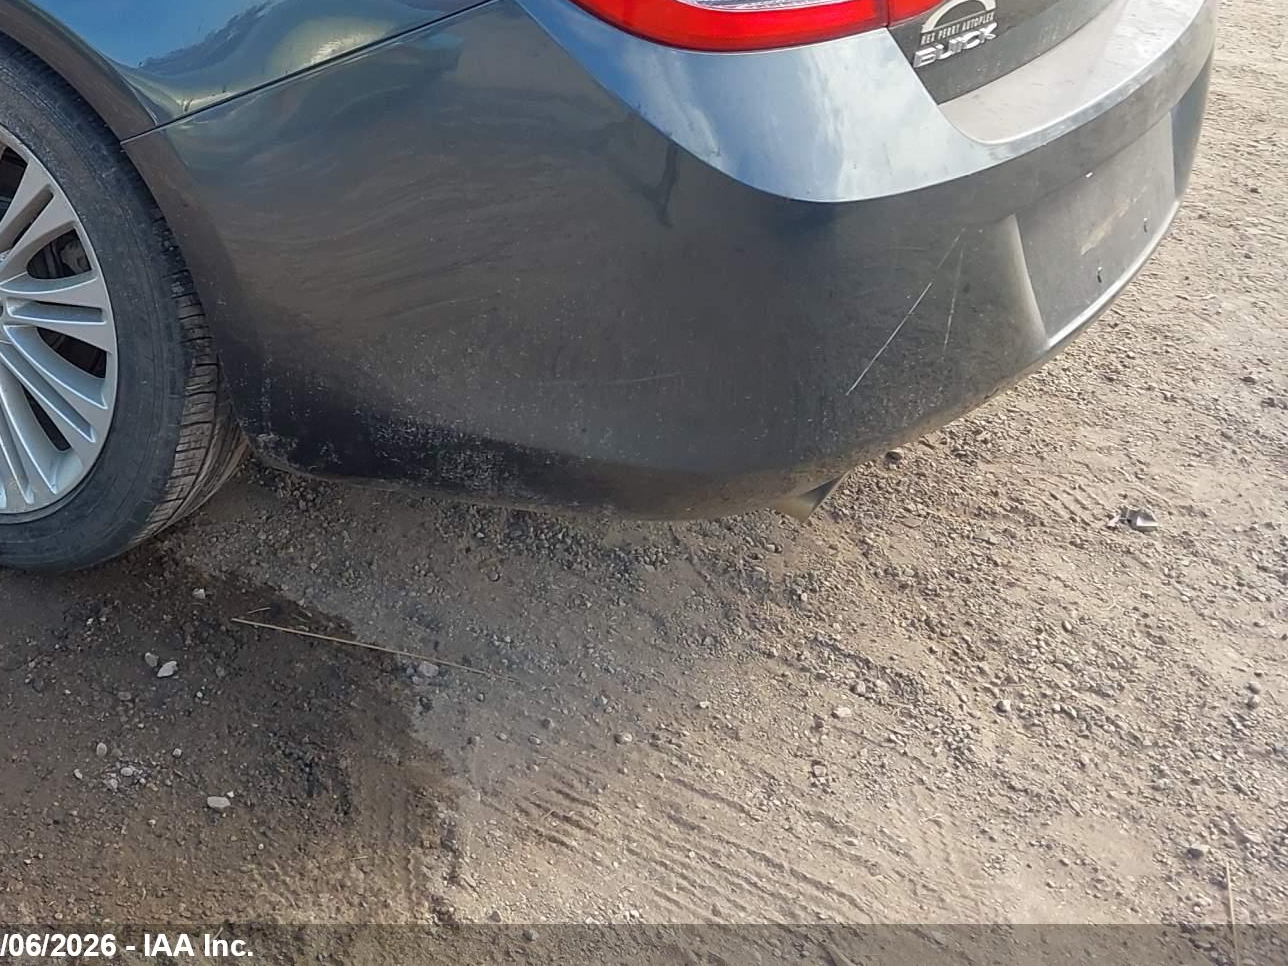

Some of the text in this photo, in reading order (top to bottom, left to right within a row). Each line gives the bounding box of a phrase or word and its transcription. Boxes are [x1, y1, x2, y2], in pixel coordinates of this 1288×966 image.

[913, 22, 998, 68] BUICK
[920, 11, 995, 46] REX PERRY AUTOPLEX
